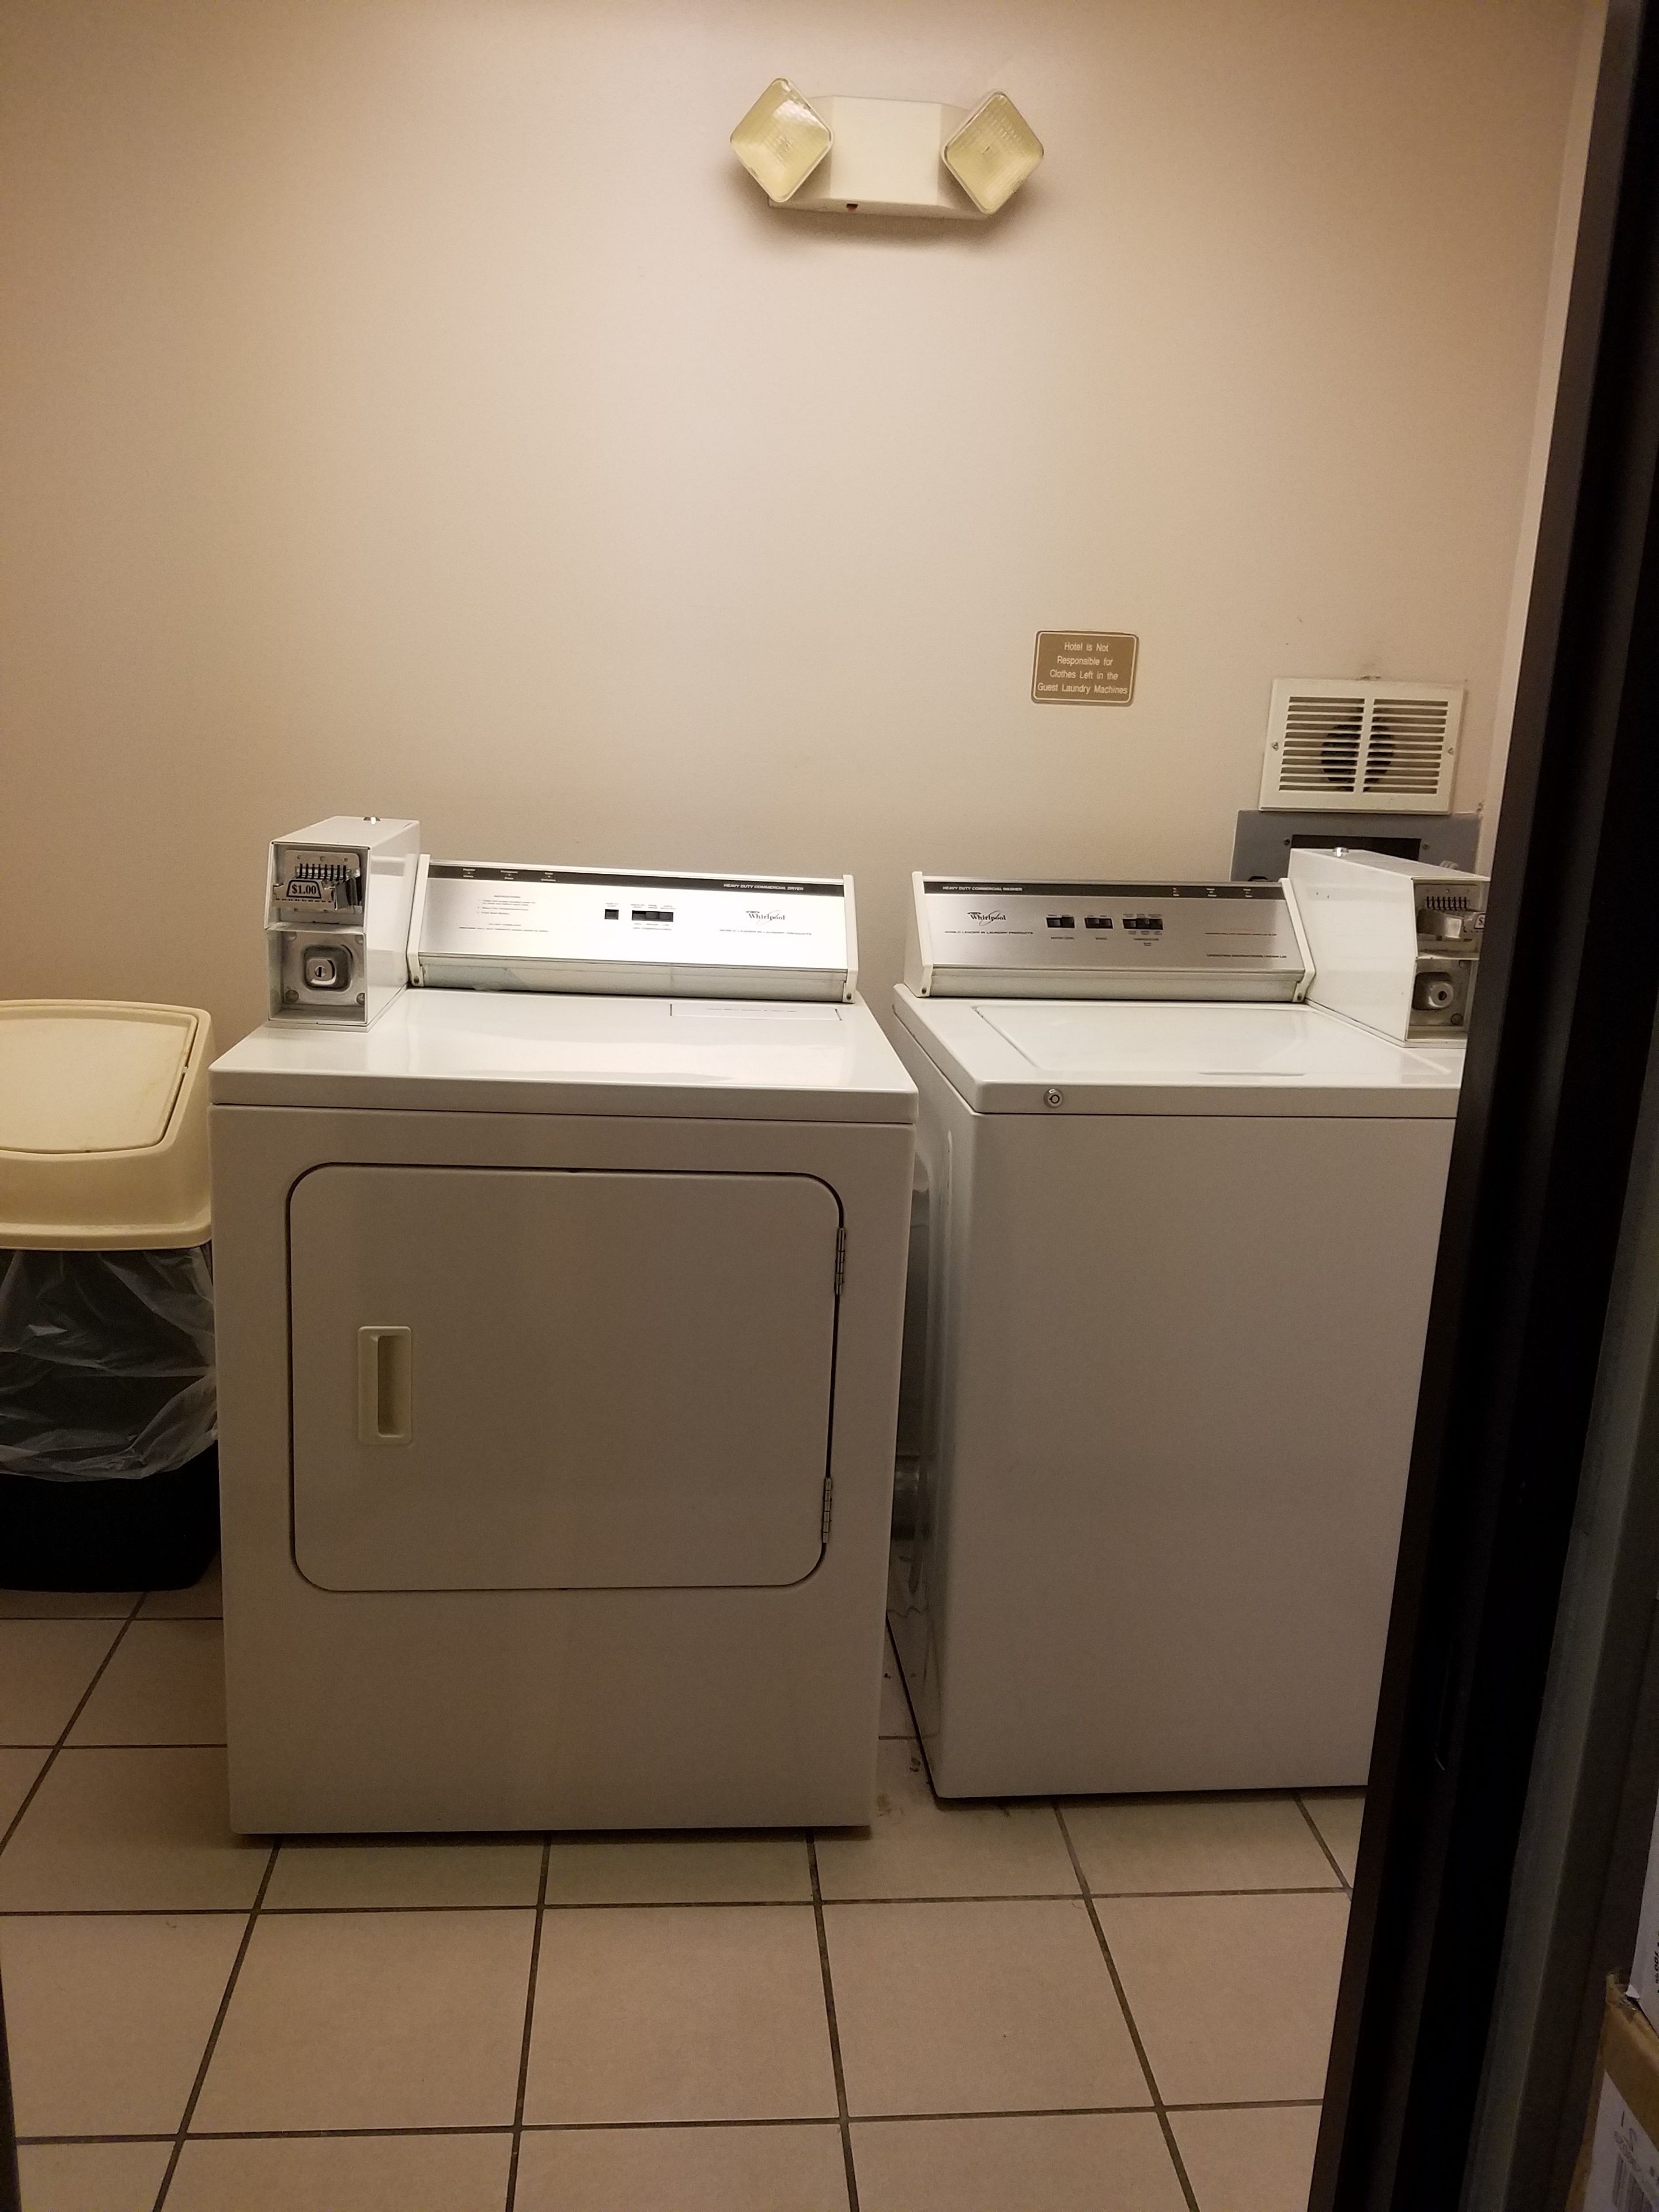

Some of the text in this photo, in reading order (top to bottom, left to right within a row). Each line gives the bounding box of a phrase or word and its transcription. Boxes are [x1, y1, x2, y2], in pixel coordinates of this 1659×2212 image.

[1064, 642, 1109, 652] Hotel is Not
[1056, 656, 1113, 666] Responsible for
[1050, 669, 1119, 680] Clothes Left in the
[1037, 683, 1128, 695] Guest Laundry Machines
[291, 884, 317, 895] $1.00
[748, 912, 785, 921] Whirlpool
[970, 914, 1006, 922] Whirlpool
